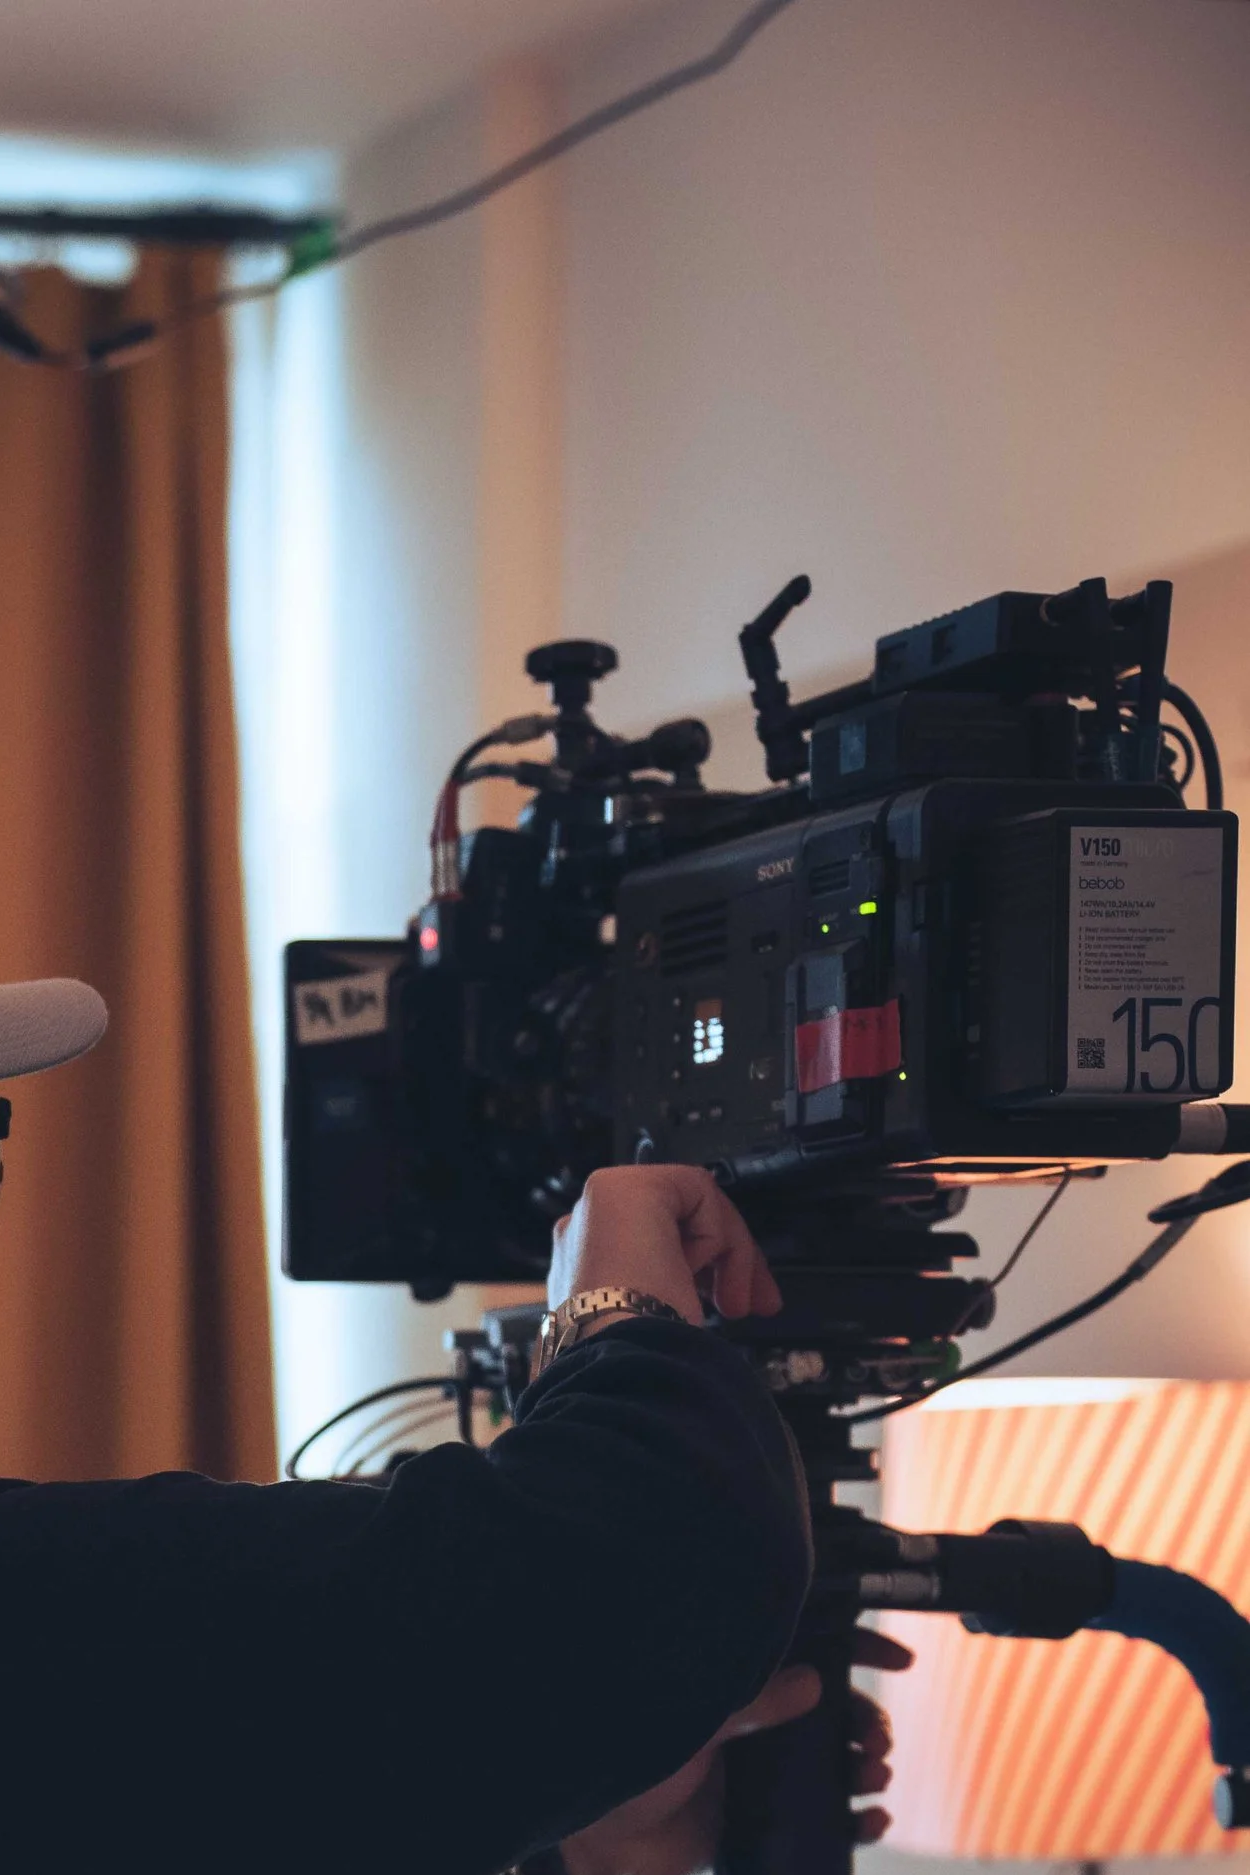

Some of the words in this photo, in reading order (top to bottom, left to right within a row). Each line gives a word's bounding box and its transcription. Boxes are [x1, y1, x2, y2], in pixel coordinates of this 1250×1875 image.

[1080, 837, 1121, 856] V150
[757, 856, 795, 882] SONY
[1079, 876, 1125, 890] bebob
[1105, 910, 1140, 918] BATTERY
